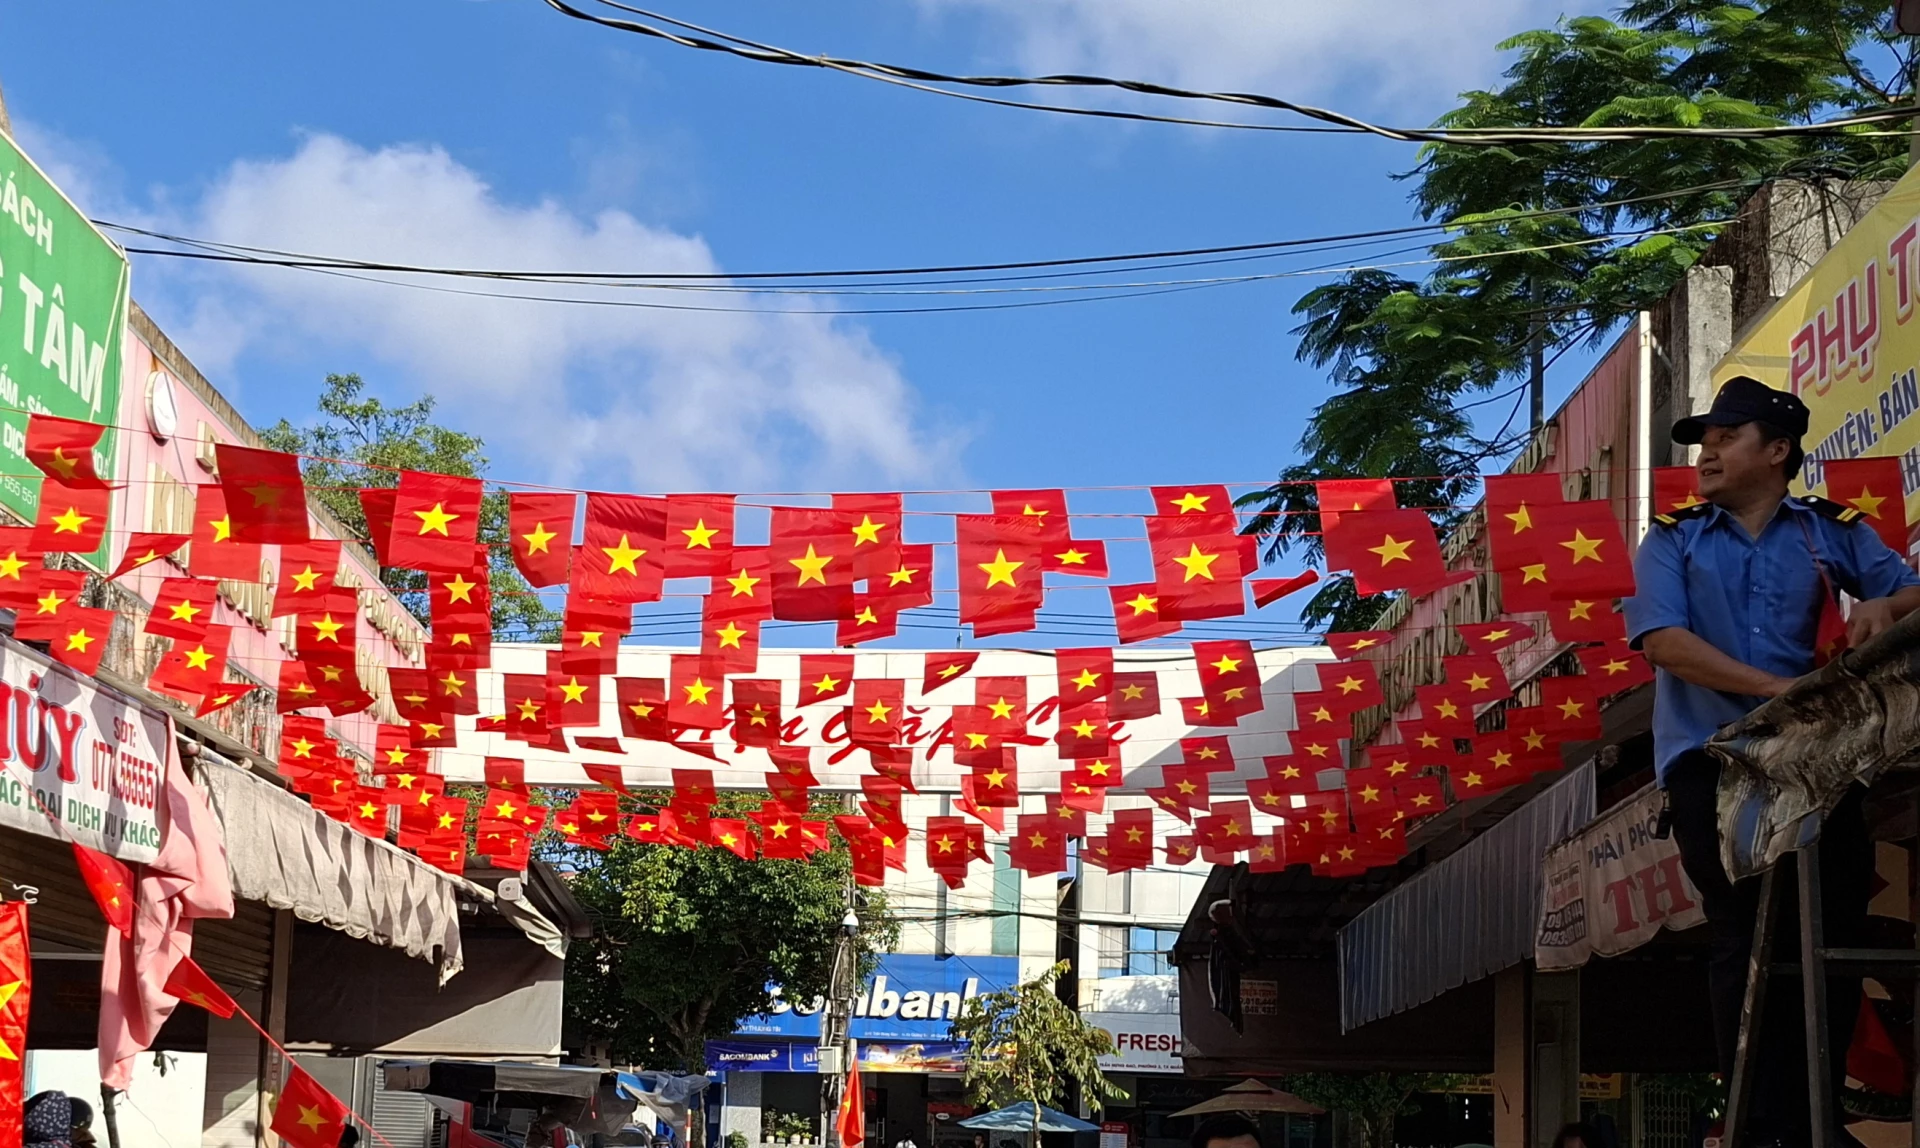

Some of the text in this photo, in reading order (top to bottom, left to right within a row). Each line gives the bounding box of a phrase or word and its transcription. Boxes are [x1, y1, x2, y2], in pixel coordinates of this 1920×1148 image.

[0, 170, 53, 256] ÁCH
[1791, 222, 1920, 397] PHỤ T
[19, 272, 104, 414] TÂM
[1879, 368, 1920, 435] BÁN
[22, 486, 37, 508] 551
[28, 784, 62, 823] LOẠI
[68, 798, 100, 831] DỊCH
[121, 820, 160, 849] KHÁC
[719, 1053, 770, 1061] SACOMBANK
[1117, 1033, 1182, 1052] FRESH
